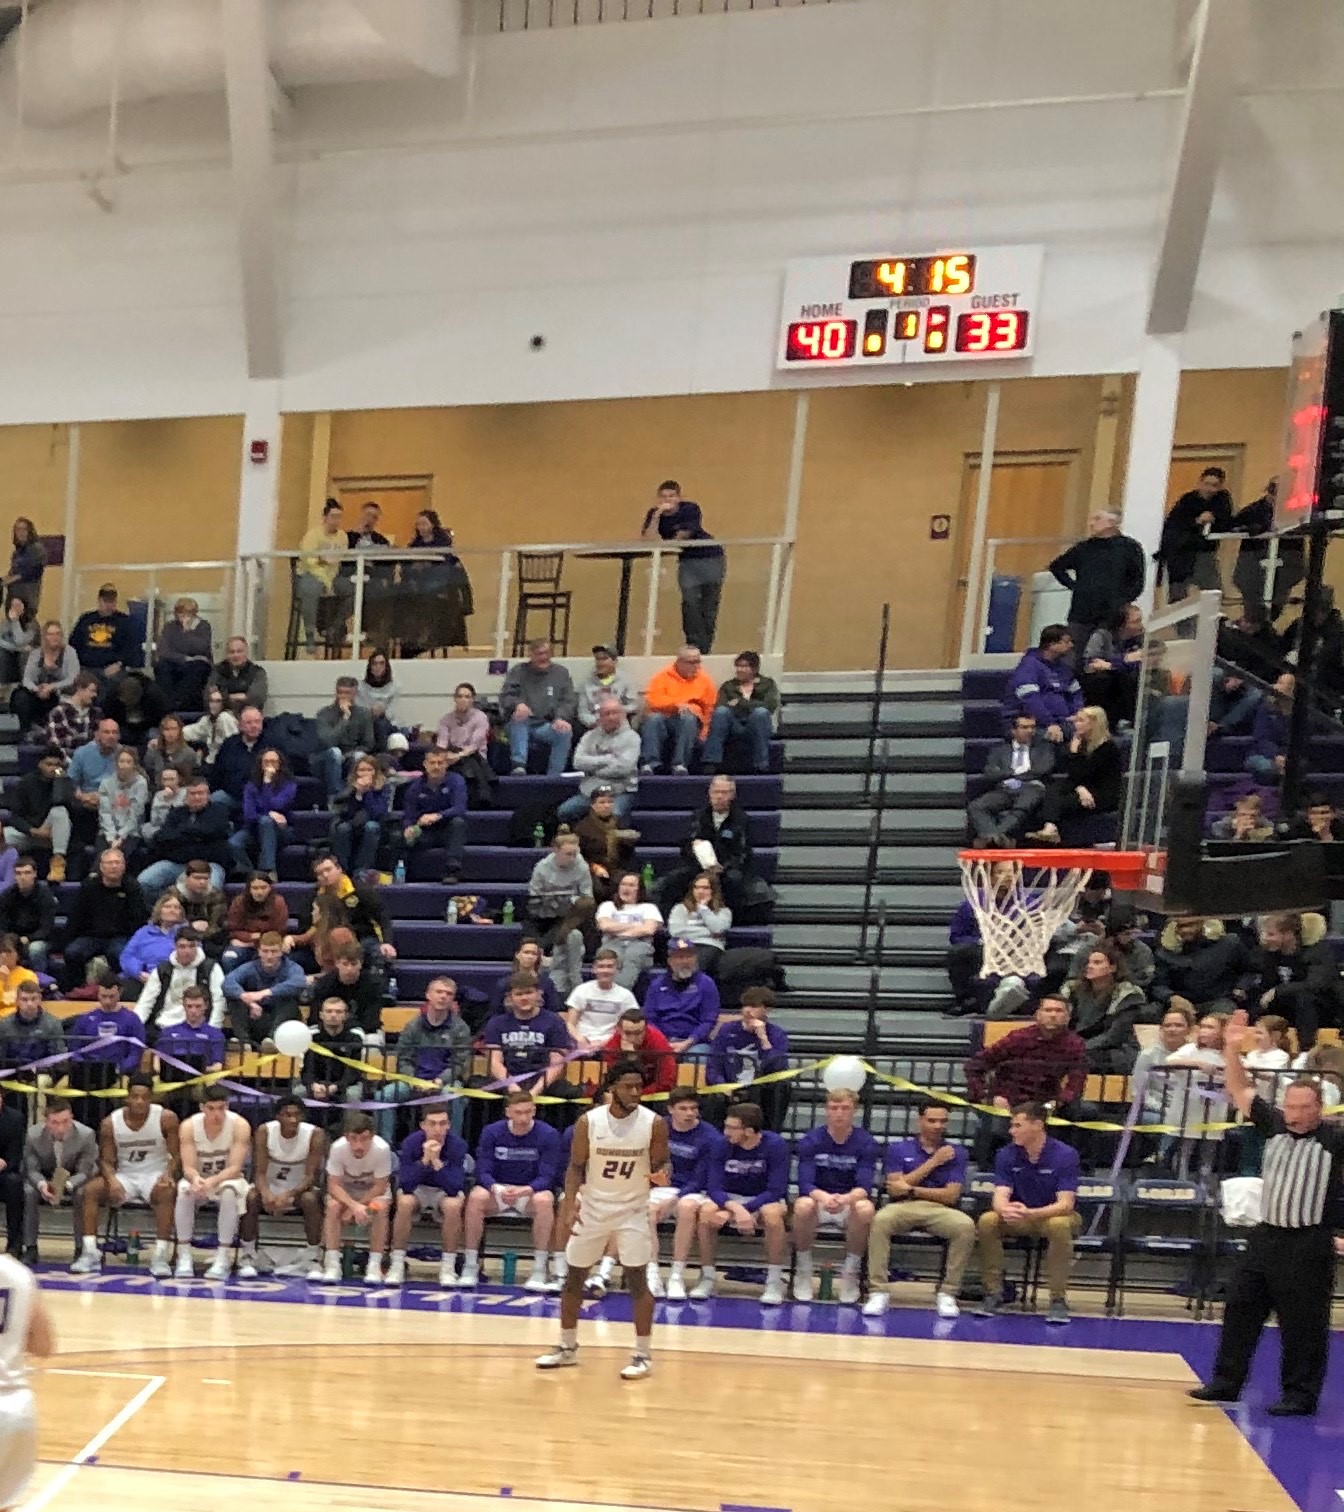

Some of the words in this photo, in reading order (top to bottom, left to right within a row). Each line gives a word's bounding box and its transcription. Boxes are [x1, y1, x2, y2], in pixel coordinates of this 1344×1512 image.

[800, 302, 843, 319] HOME
[970, 292, 1021, 309] GUEST
[797, 321, 847, 358] 40
[967, 312, 1018, 352] 33
[602, 1160, 636, 1180] 24
